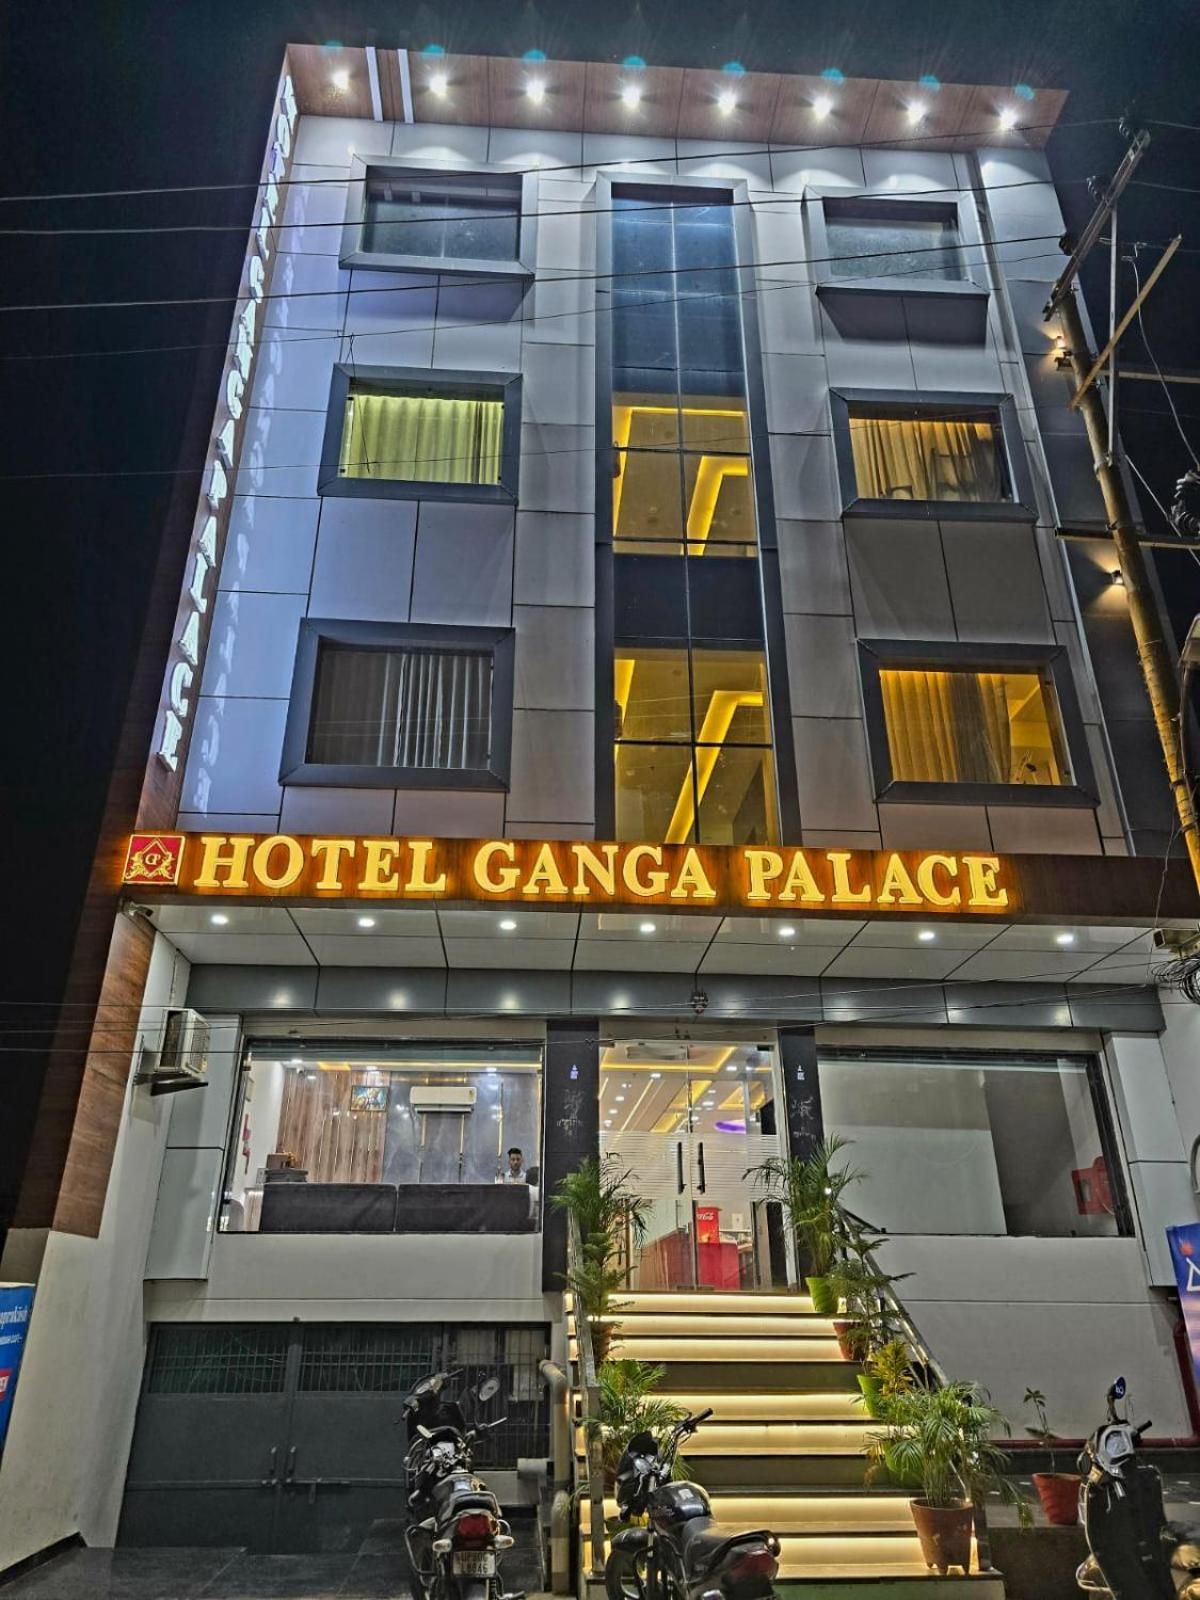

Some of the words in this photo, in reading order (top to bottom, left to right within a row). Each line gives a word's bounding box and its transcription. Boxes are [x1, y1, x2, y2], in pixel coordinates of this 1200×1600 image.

[156, 460, 227, 773] PALACE
[194, 835, 447, 893] HOTEL
[473, 841, 717, 899] GANGA
[744, 849, 1009, 908] PALACE
